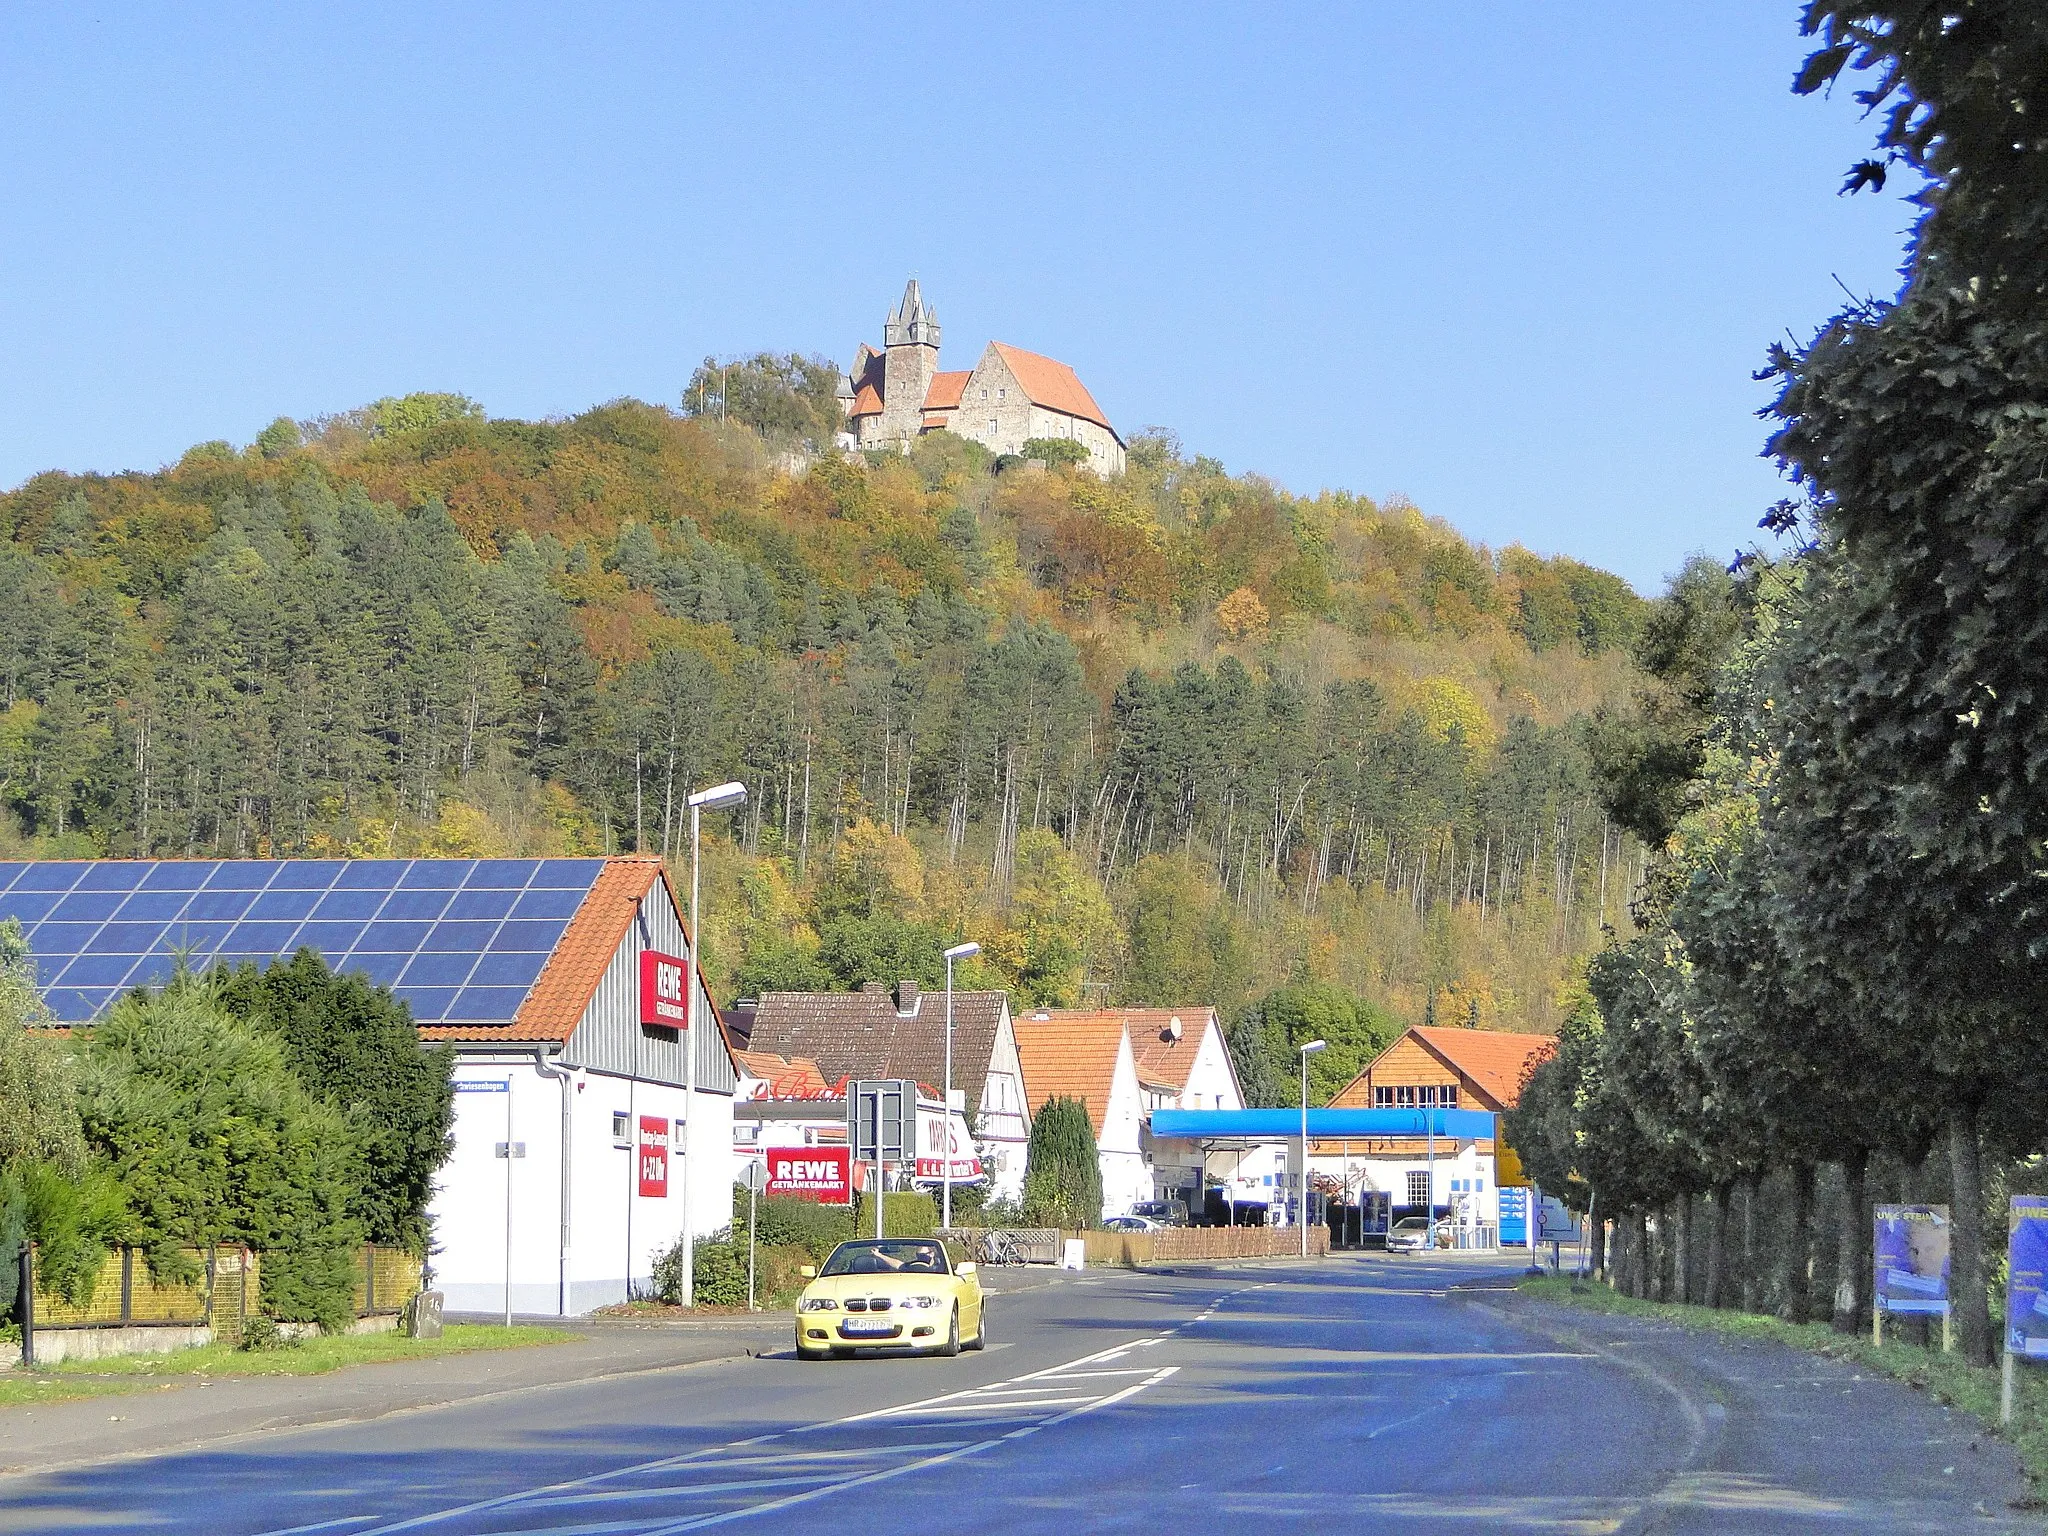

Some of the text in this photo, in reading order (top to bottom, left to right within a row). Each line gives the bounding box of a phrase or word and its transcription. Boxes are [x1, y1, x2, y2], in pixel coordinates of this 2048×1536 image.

[657, 961, 682, 1001] REWE
[777, 1160, 839, 1180] REWE
[771, 1180, 845, 1189] GETRÄNKEMARKT
